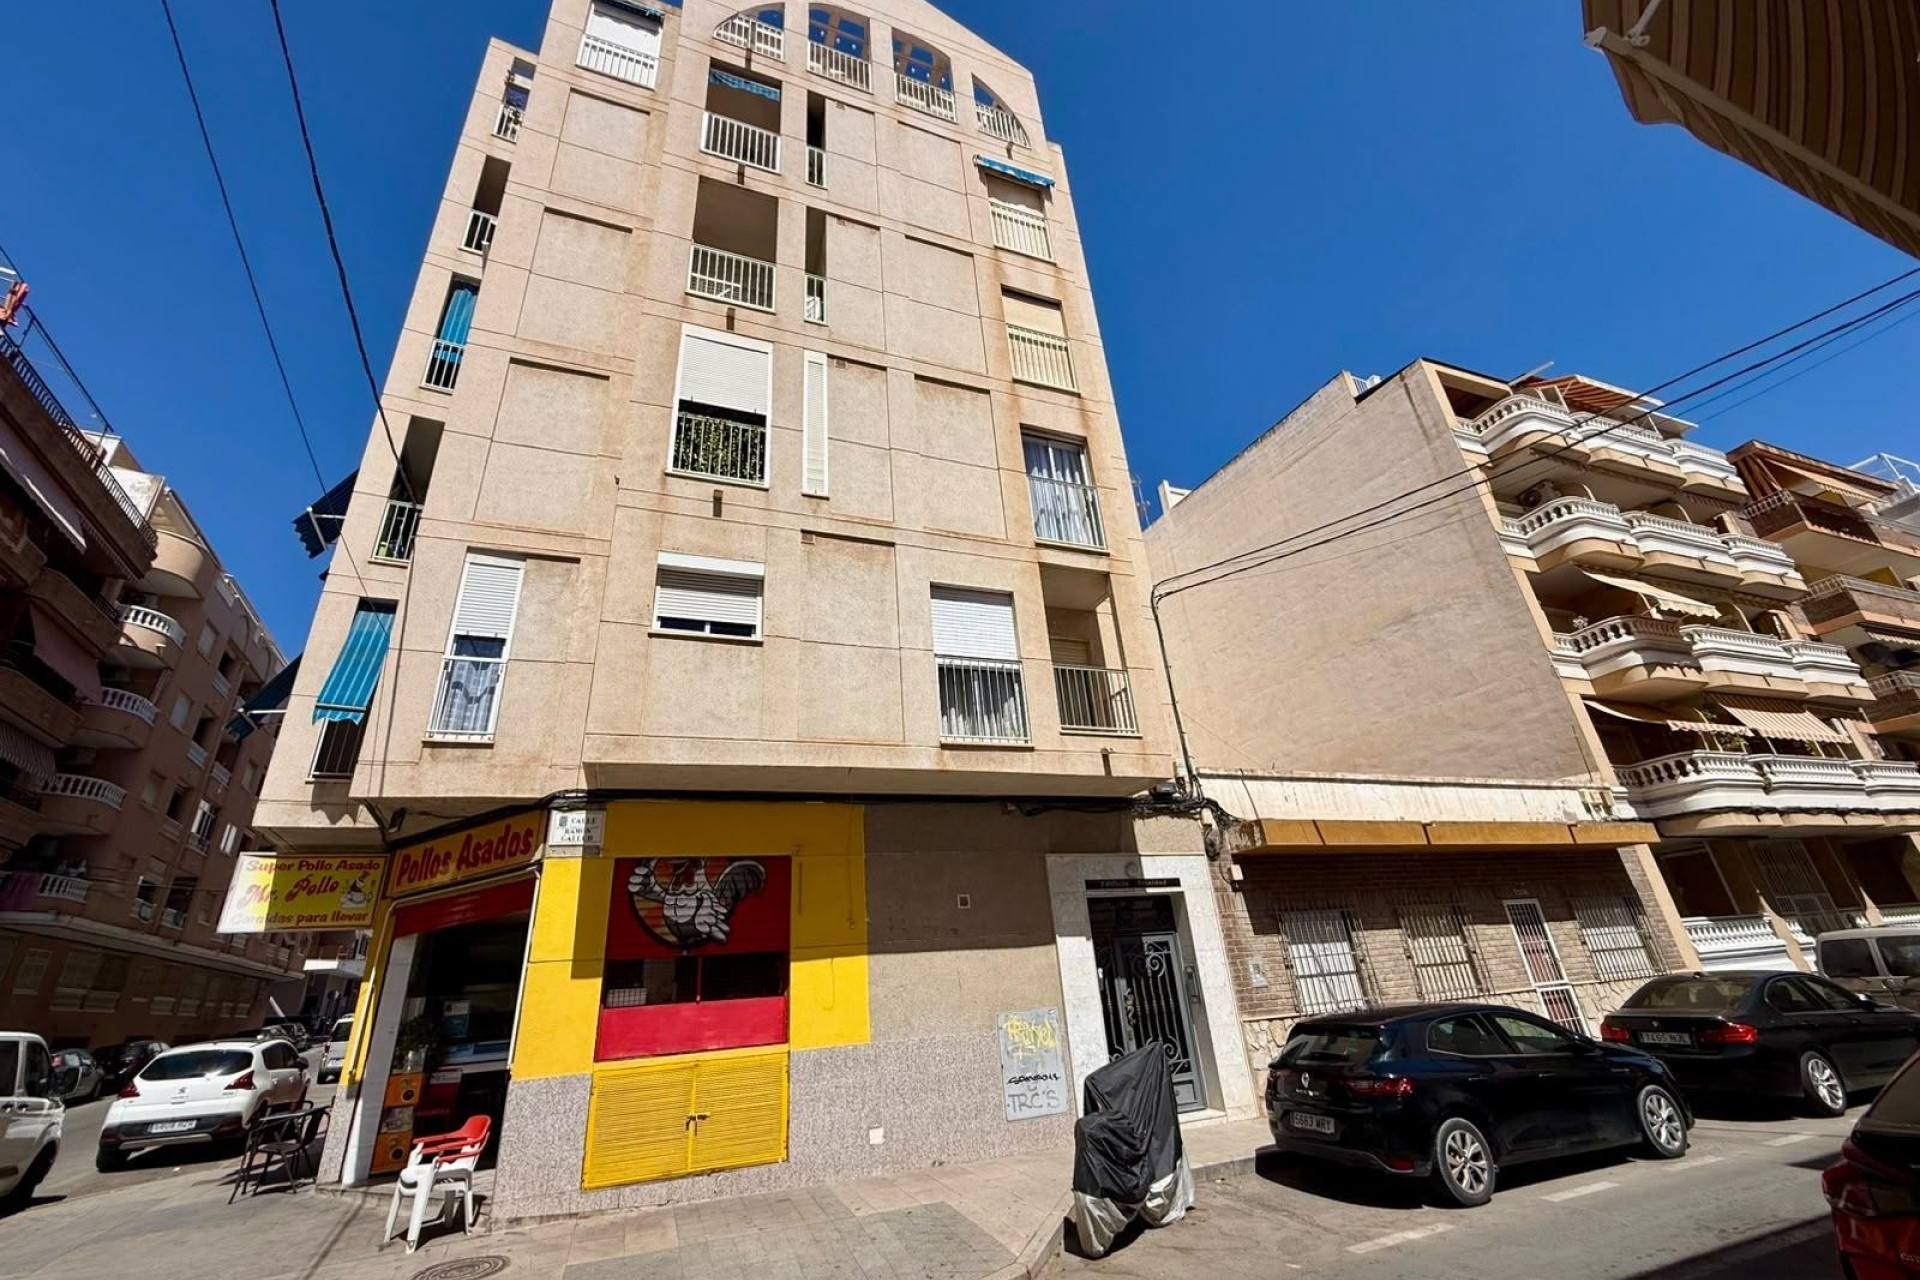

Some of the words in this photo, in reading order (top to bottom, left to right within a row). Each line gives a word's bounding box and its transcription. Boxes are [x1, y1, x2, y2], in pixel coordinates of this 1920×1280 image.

[246, 859, 294, 874] Super
[297, 860, 333, 871] Pollo
[336, 859, 380, 871] Asado
[396, 845, 452, 887] Pollos
[456, 823, 534, 871] Asados
[236, 883, 278, 910] Mr.
[284, 873, 340, 903] Pollo
[232, 911, 292, 924] Comidas
[296, 912, 327, 925] para
[331, 909, 369, 921] llevar
